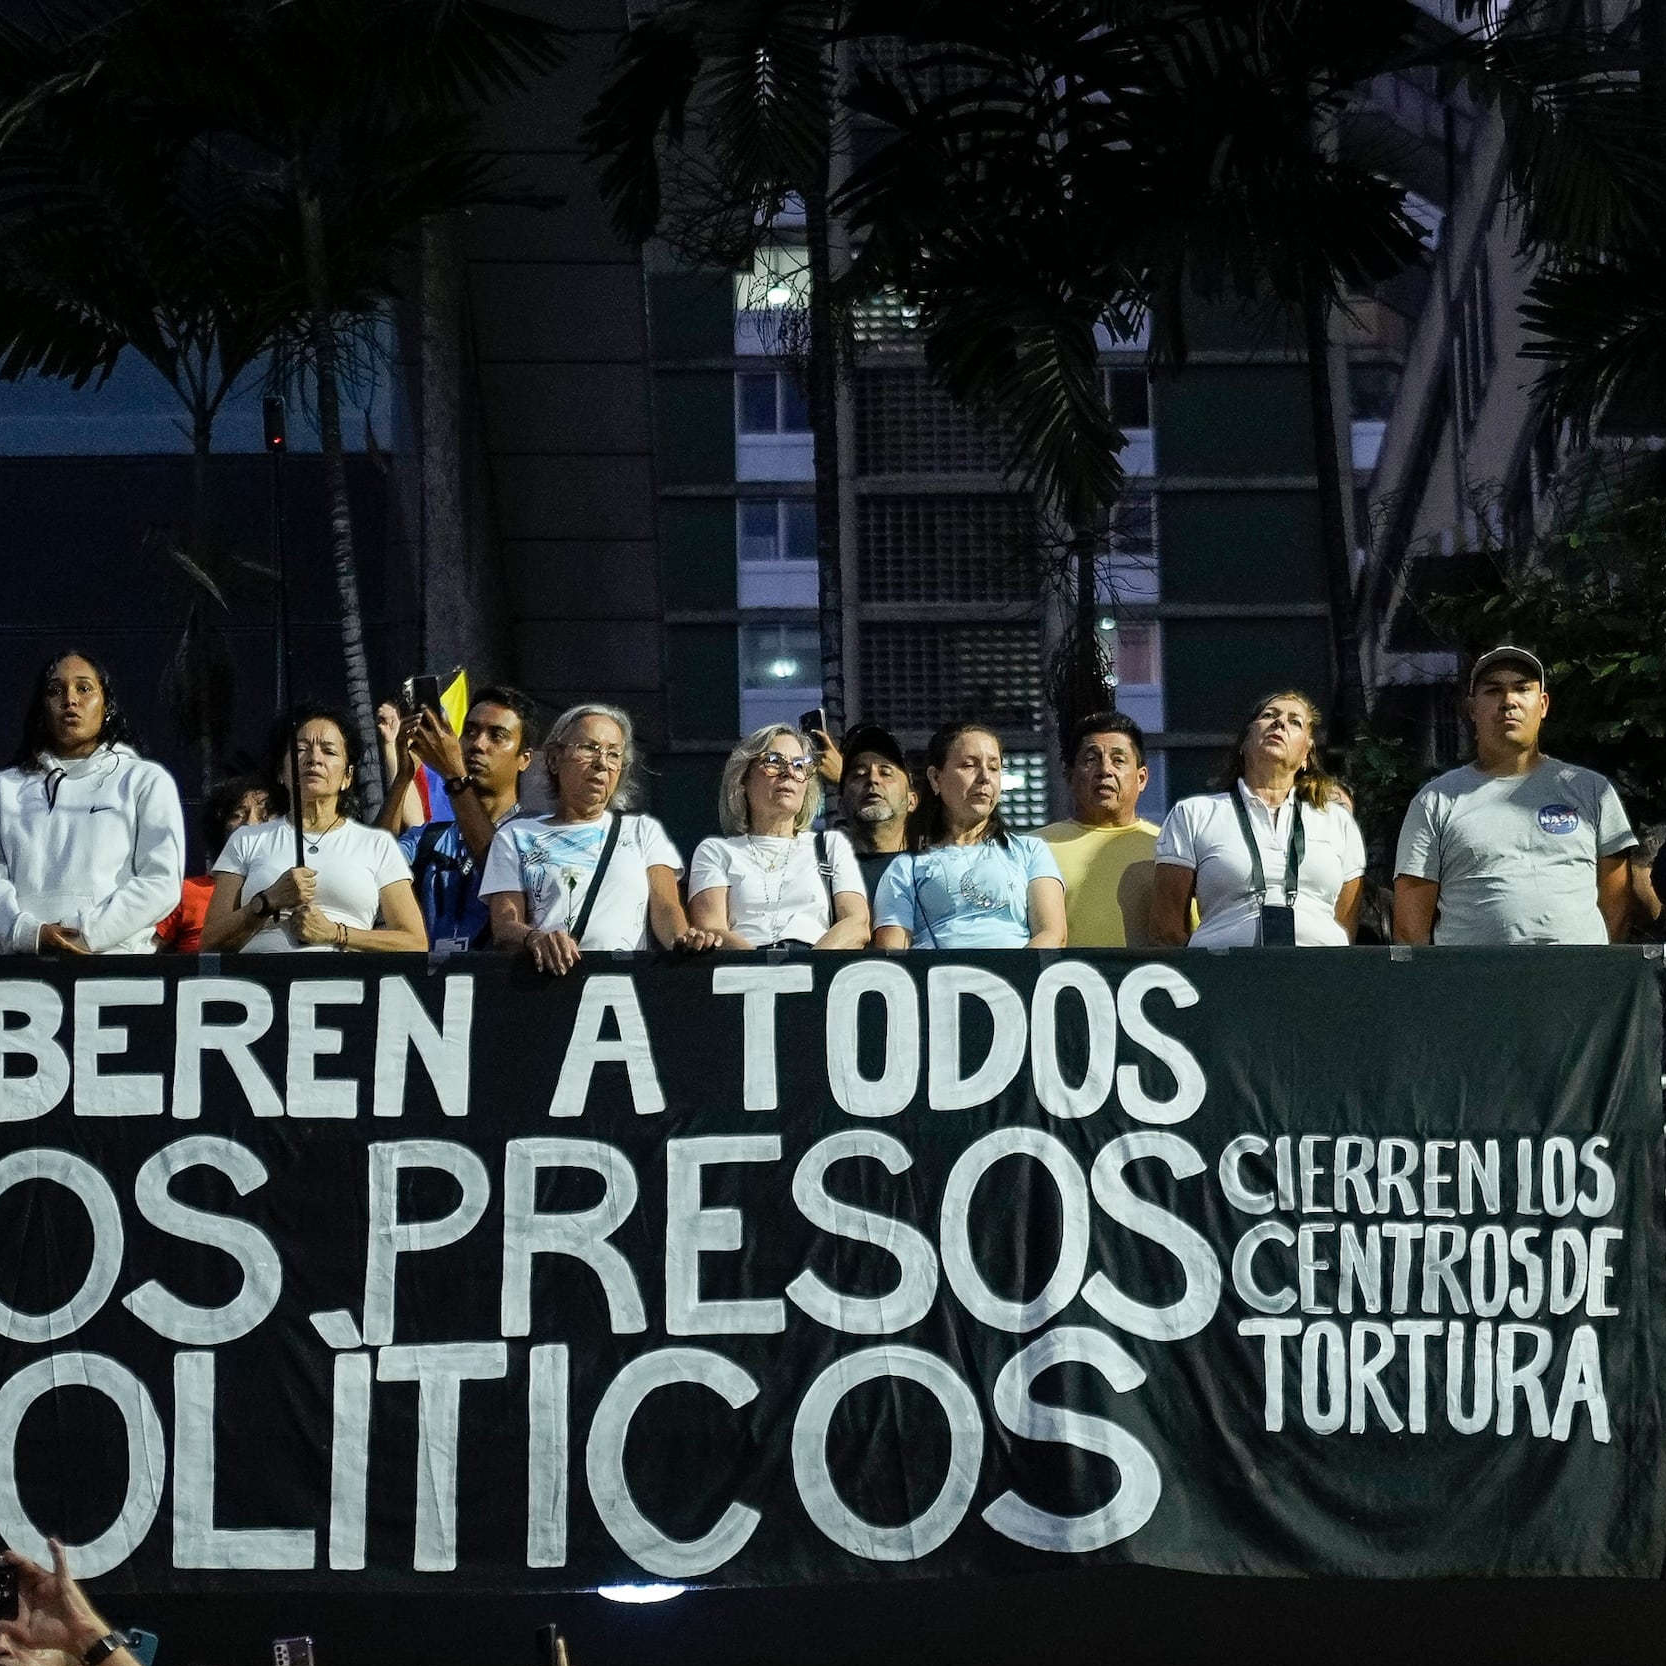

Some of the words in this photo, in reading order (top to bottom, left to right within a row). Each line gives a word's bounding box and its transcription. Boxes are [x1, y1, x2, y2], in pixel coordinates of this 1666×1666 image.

[1539, 814, 1577, 829] NASA
[550, 974, 666, 1118] A
[713, 960, 1206, 1124] TODOS
[1218, 1133, 1500, 1219] CIERREN
[1515, 1135, 1617, 1219] LOS
[364, 1127, 1222, 1347] PRESOS
[1231, 1220, 1545, 1318] CENTROS
[1550, 1226, 1624, 1318] DE
[1238, 1317, 1613, 1443] TORTURA
